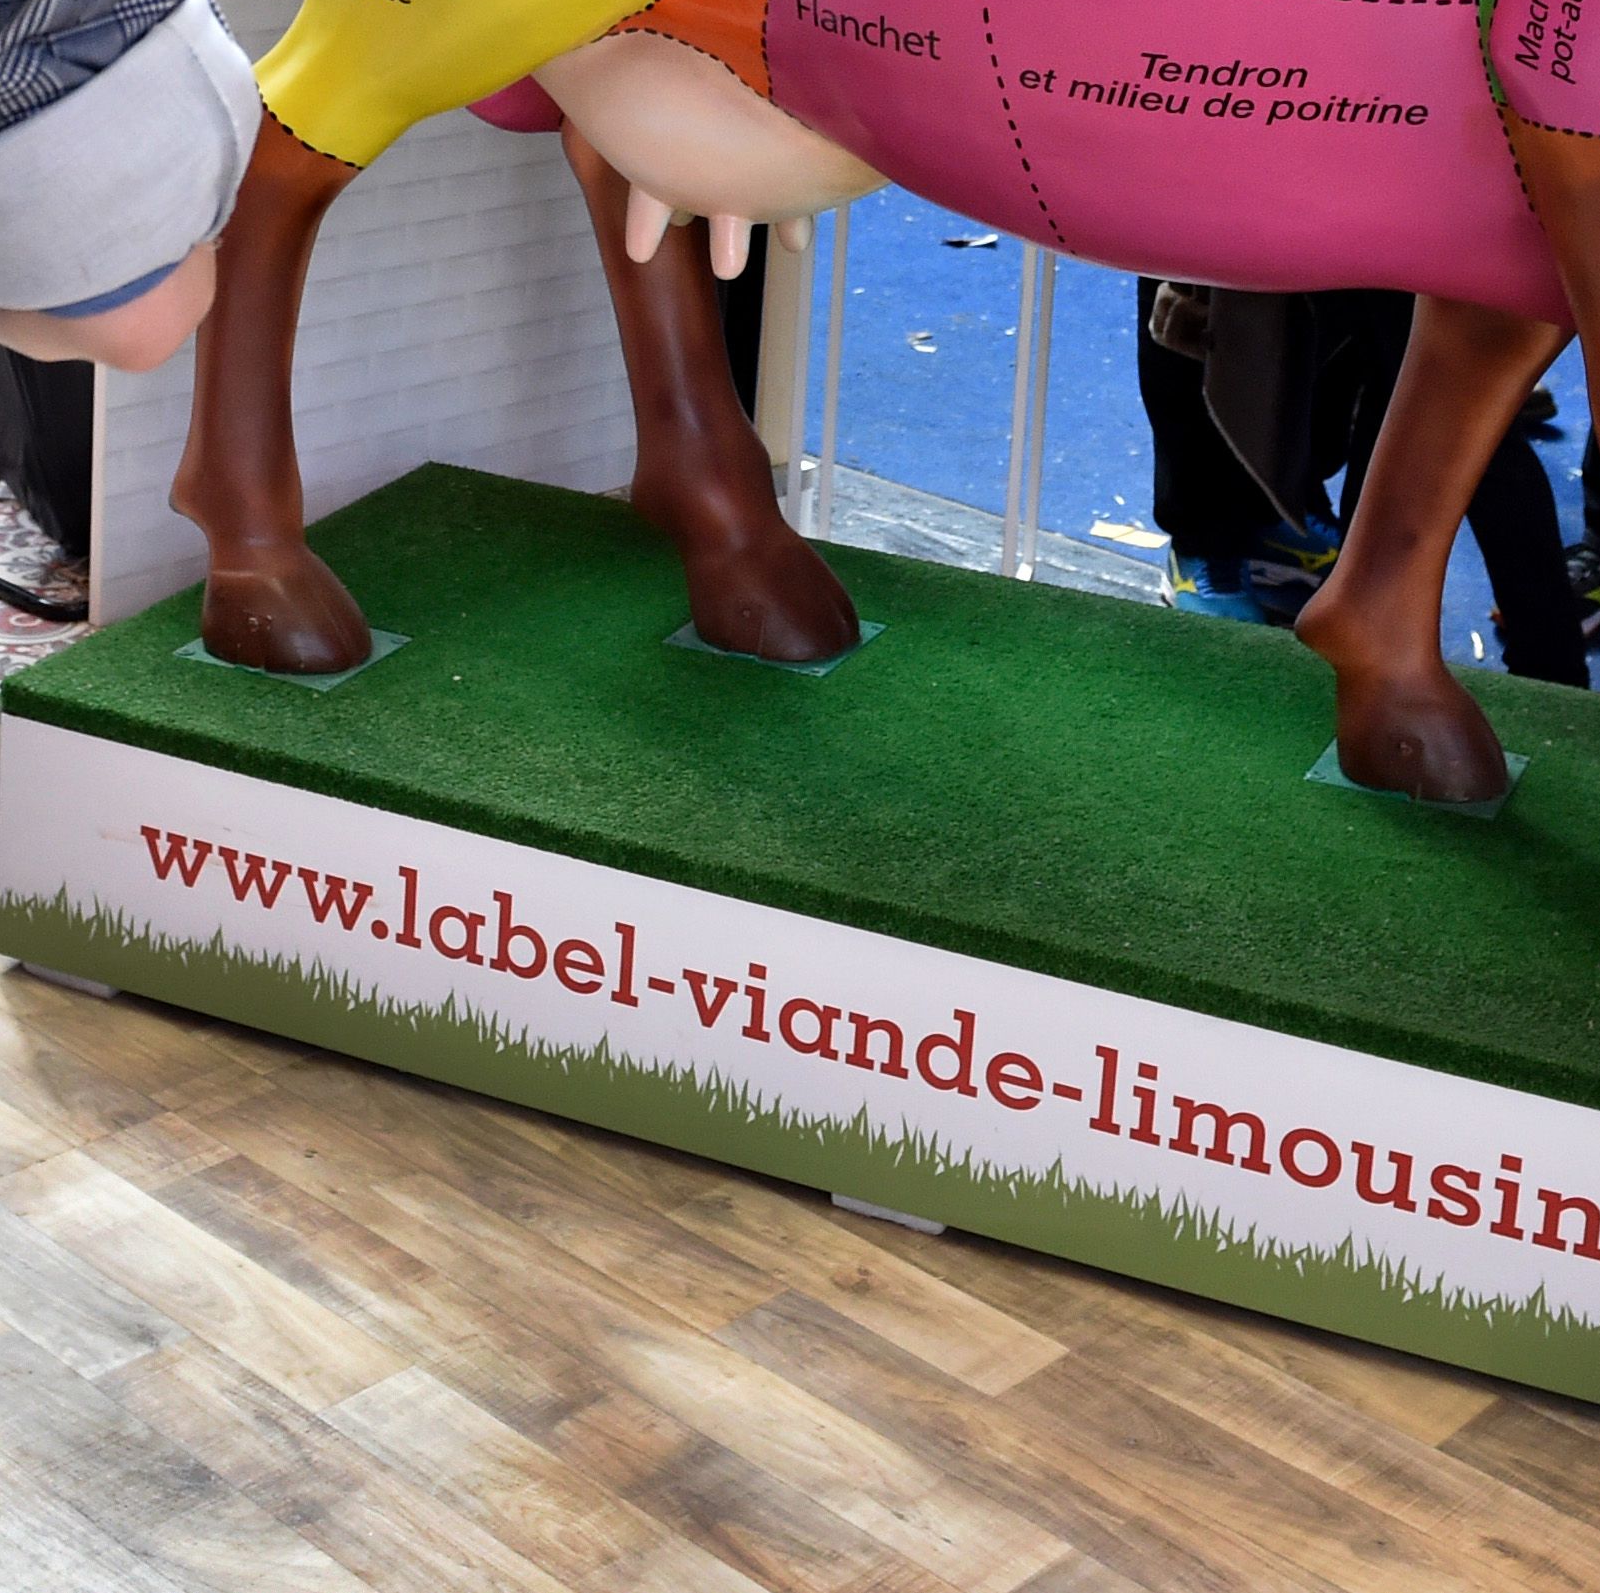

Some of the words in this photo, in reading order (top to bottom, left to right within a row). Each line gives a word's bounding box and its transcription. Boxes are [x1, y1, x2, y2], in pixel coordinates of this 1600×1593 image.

[1140, 52, 1309, 89] Tendron
[1018, 69, 1057, 90] et
[1068, 78, 1190, 115] milieu
[1203, 92, 1255, 119] de
[1266, 95, 1429, 126] poitrine
